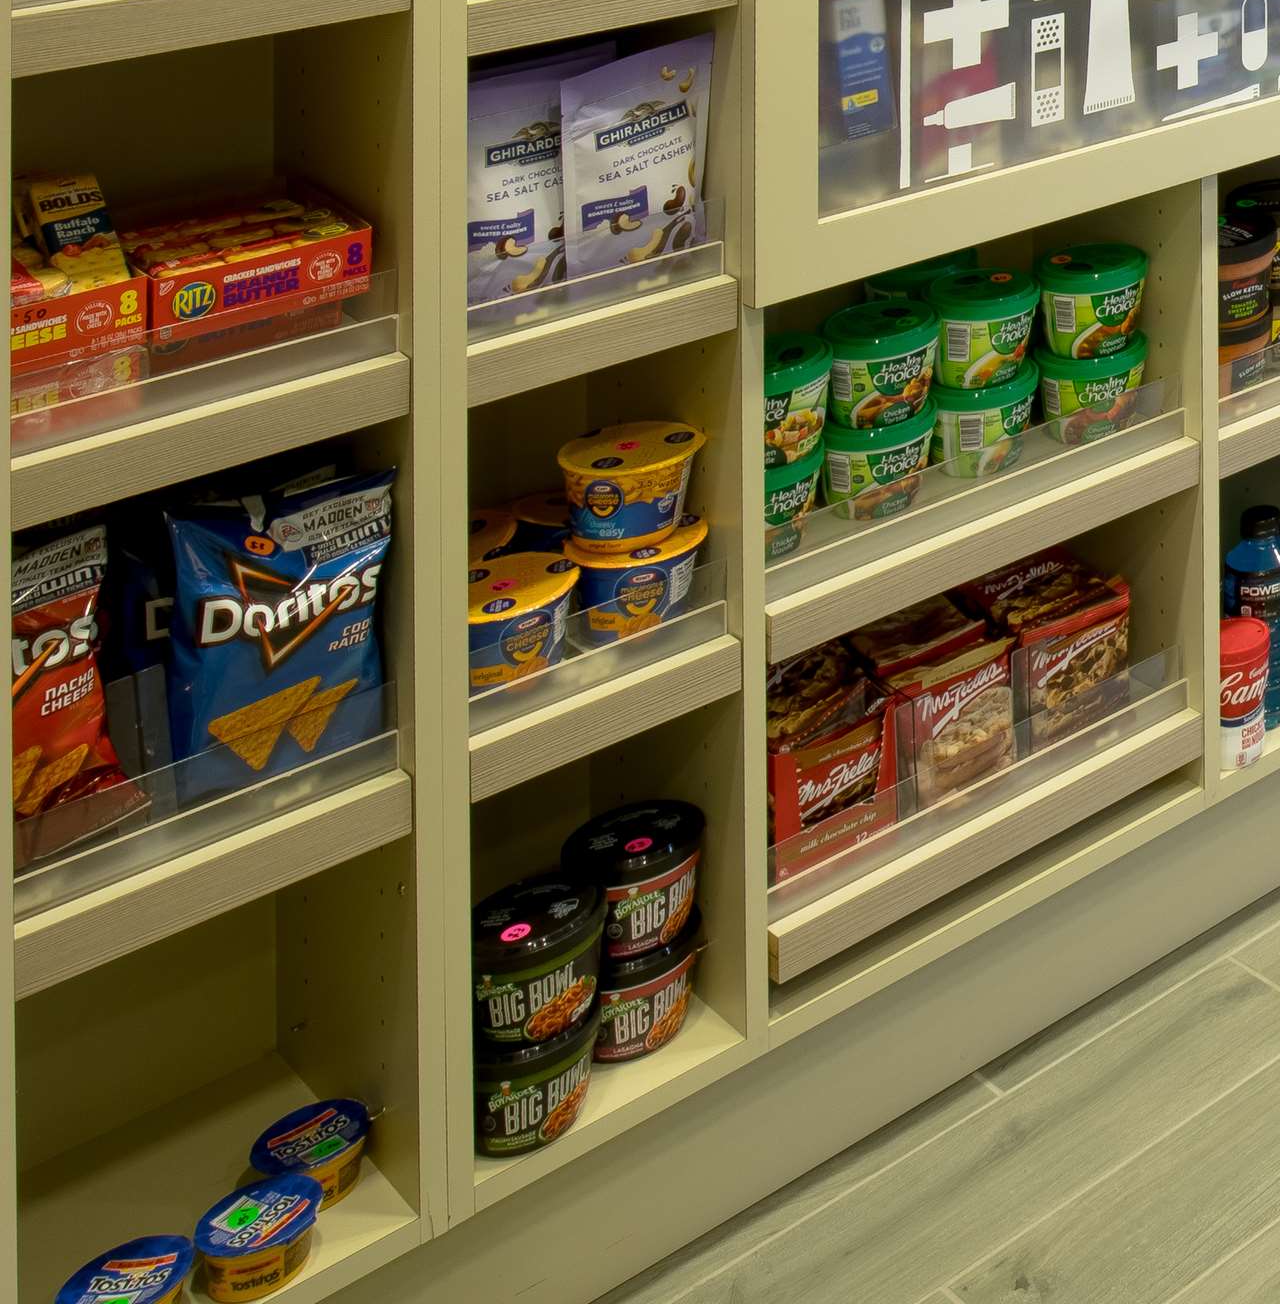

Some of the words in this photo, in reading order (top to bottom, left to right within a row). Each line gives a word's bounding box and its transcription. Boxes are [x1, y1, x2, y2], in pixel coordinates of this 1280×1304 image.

[599, 106, 688, 147] GHIRARDELLI
[612, 155, 635, 168] DARK
[637, 136, 683, 160] CHOCOLATE
[598, 171, 622, 184] SEA
[625, 159, 650, 176] SALT
[39, 189, 103, 214] BOLDS
[54, 216, 100, 232] Buffalo
[56, 225, 96, 241] Ranch
[346, 242, 364, 266] 8
[119, 288, 138, 315] 8
[174, 284, 213, 319] RITZ
[115, 312, 143, 328] PACKS
[303, 505, 363, 534] MADDEN
[599, 526, 624, 539] easy
[200, 563, 383, 645] Doritos
[40, 680, 95, 717] CHEESE
[44, 667, 95, 702] NACHO
[630, 896, 666, 940] BIG
[489, 985, 526, 1028] BIG
[528, 960, 578, 1013] BOWL
[503, 1092, 543, 1136] BIG
